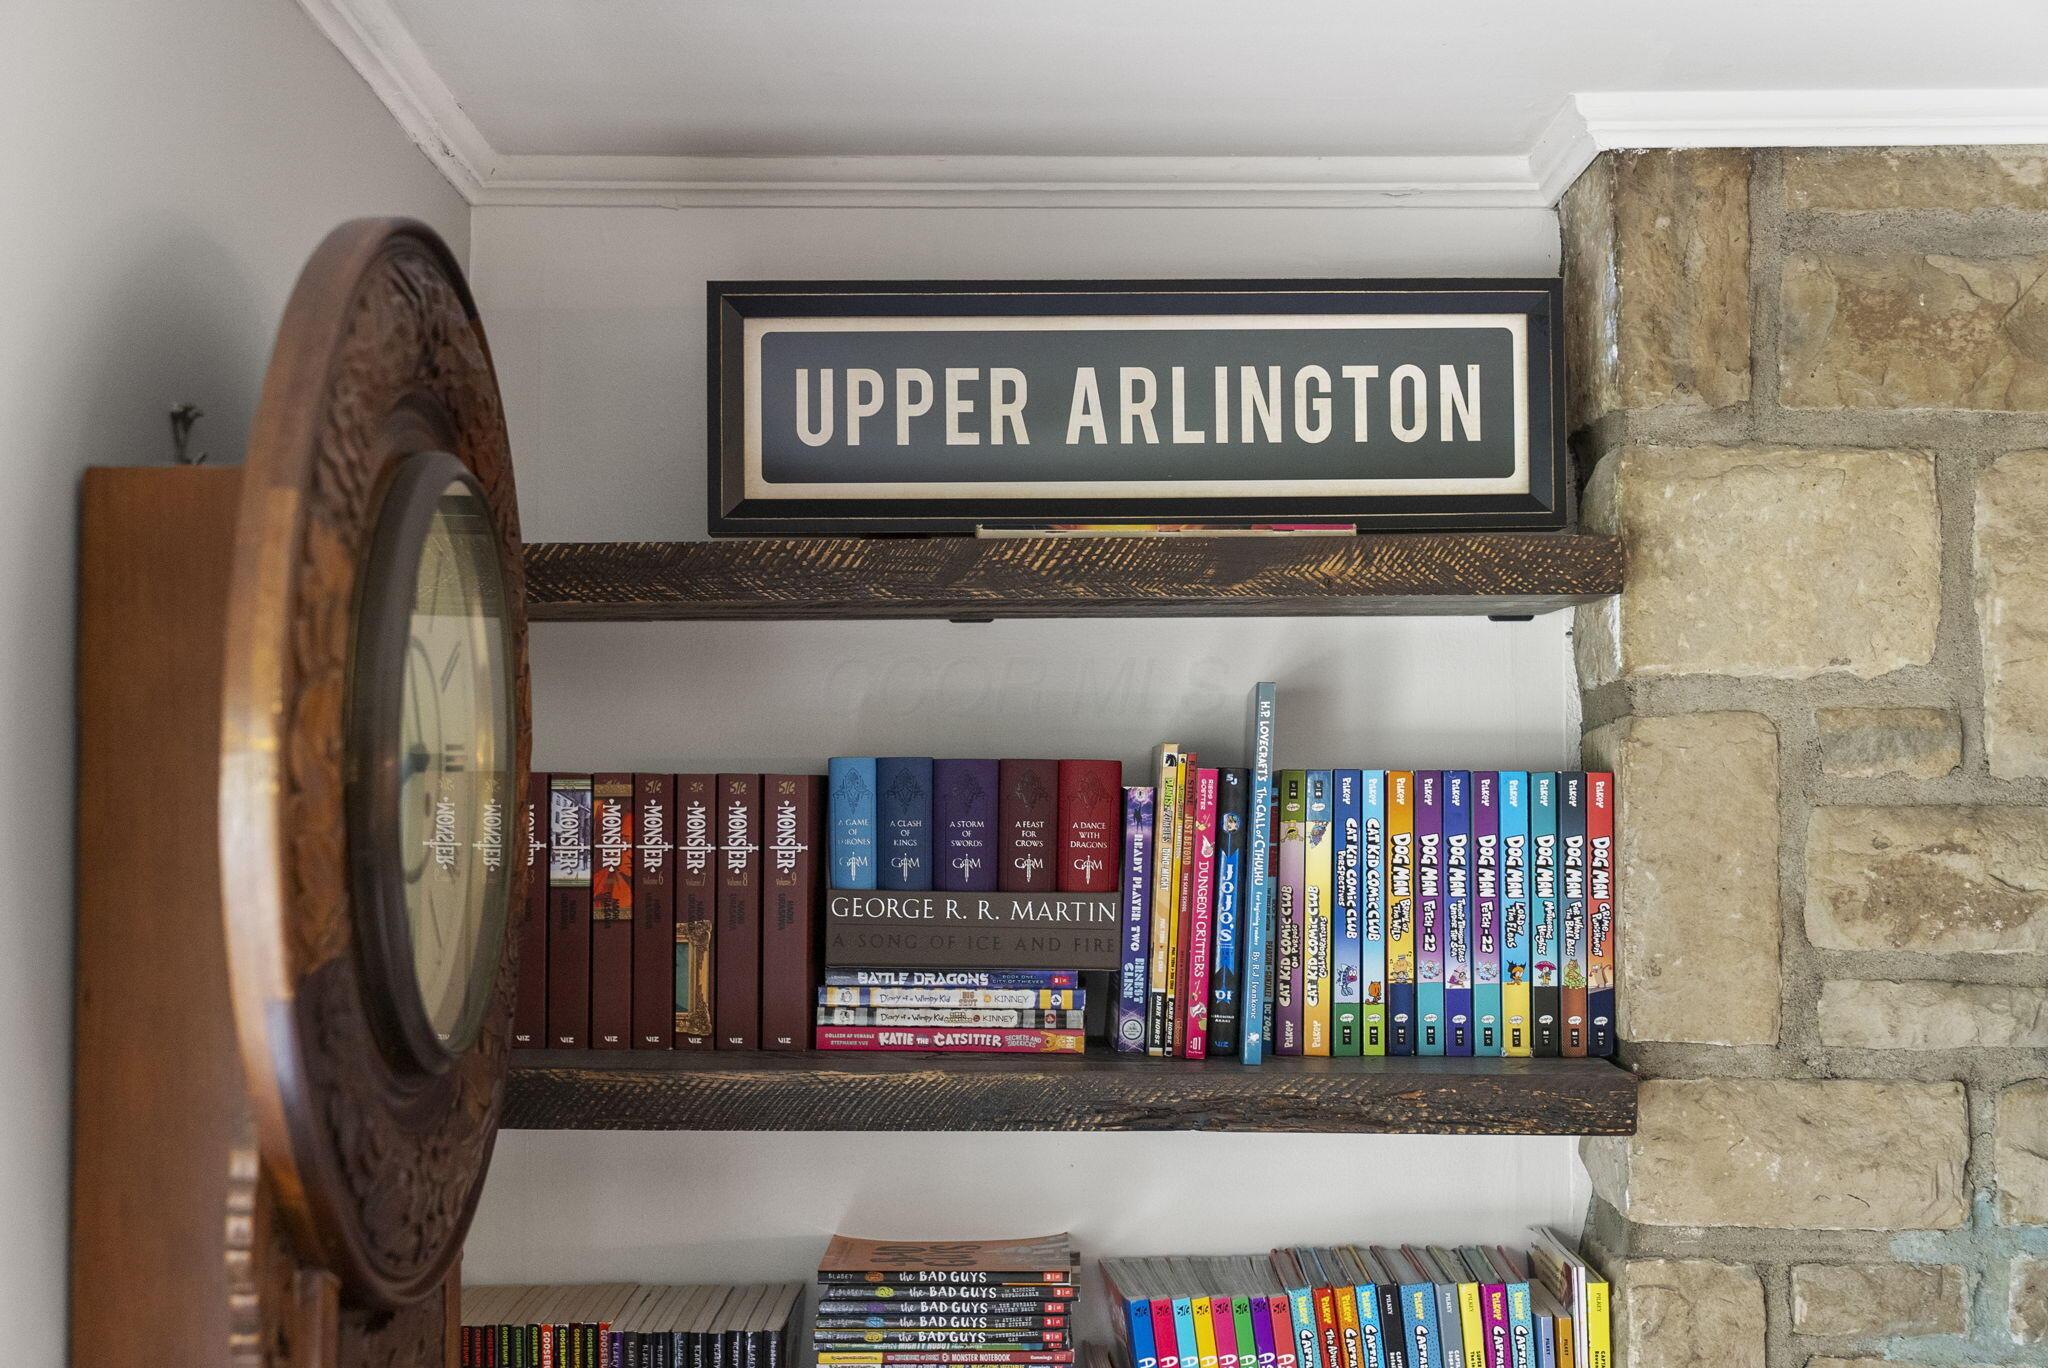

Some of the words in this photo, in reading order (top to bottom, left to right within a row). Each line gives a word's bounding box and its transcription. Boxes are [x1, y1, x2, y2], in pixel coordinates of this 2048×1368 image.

[796, 367, 1030, 447] UPPER
[1066, 364, 1482, 446] ARLINGTON
[1260, 700, 1270, 718] H.P.
[1257, 721, 1270, 782] LOVECRAFT'S
[1165, 777, 1174, 806] PLANTS
[1256, 787, 1268, 803] The
[1184, 813, 1193, 835] JUST
[1254, 804, 1267, 827] CALL
[1346, 818, 1358, 842] CAT
[1367, 818, 1380, 843] CAT
[554, 806, 588, 871] MONSTER
[597, 803, 629, 869] MONSTER
[638, 803, 670, 870] MONSTER
[681, 805, 713, 871] MONSTER
[722, 805, 755, 871] MONSTER
[771, 805, 804, 871] MONSTER
[951, 840, 983, 848] SWORDS
[1182, 835, 1193, 865] BEYOND
[1255, 829, 1264, 840] of
[1391, 832, 1411, 865] DOG
[1420, 833, 1440, 866] DOG
[1448, 834, 1468, 866] DOG
[1477, 834, 1497, 866] DOG
[1133, 834, 1144, 873] READY
[1253, 840, 1266, 886] CTHULHU
[1505, 835, 1525, 867] DOG
[1536, 834, 1555, 867] DOG
[1565, 835, 1584, 867] DOG
[1591, 836, 1611, 868] DOG
[1196, 861, 1209, 919] DUNGEON
[1391, 865, 1410, 896] MAN
[1420, 866, 1439, 897] MAN
[1449, 866, 1467, 897] MAN
[1478, 866, 1496, 898] MAN
[1506, 867, 1524, 899] MAN
[1537, 867, 1555, 899] MAN
[1565, 868, 1583, 899] MAN
[1592, 868, 1611, 900] MAN
[831, 896, 935, 919] GEORGE
[945, 899, 967, 920] R.
[978, 900, 1000, 920] R.
[1010, 900, 1116, 922] MARTIN
[1131, 876, 1142, 921] PLAYER
[1219, 864, 1234, 942] JOJO'S
[1281, 885, 1293, 916] CLUB
[1308, 885, 1320, 915] CLUB
[1130, 925, 1141, 952] TWO
[1346, 908, 1358, 939] CLUB
[1368, 909, 1381, 941] CLUB
[858, 934, 917, 949] SONG
[930, 935, 956, 949] OF
[967, 936, 1000, 951] ICE
[1015, 938, 1061, 951] AND
[1074, 938, 1114, 953] FIRE
[1194, 923, 1206, 978] CRITTERS
[1252, 951, 1261, 962] By
[857, 971, 909, 985] BATTLE
[914, 972, 989, 986] DRAGONS
[1291, 957, 1299, 969] ON
[1123, 962, 1134, 999] CLINE
[1133, 957, 1145, 1004] ERNEST
[1279, 984, 1291, 1008] CAT
[1306, 983, 1319, 1007] CAT
[880, 993, 901, 1004] Diary
[915, 994, 938, 1003] Wimpy
[940, 994, 951, 1003] Kid
[994, 995, 1029, 1004] KINNEY
[1250, 981, 1260, 1019] Ivankovic
[1264, 1003, 1272, 1014] DC
[881, 1013, 900, 1022] Diary
[912, 1014, 933, 1022] Wimpy
[934, 1013, 944, 1021] Kid
[982, 1014, 1015, 1022] KINNEY
[1263, 1016, 1272, 1041] ZOOM
[879, 1032, 915, 1046] KATIE
[916, 1037, 929, 1045] THE
[934, 1032, 1002, 1047] CATSITTER
[899, 1271, 916, 1282] the
[919, 1271, 947, 1282] BAD
[950, 1271, 987, 1283] GUYS
[909, 1286, 926, 1297] the
[929, 1286, 957, 1298] BAD
[960, 1286, 997, 1299] GUYS
[900, 1302, 917, 1313] the
[920, 1301, 948, 1313] BAD
[951, 1301, 988, 1314] GUYS
[1385, 1294, 1393, 1315] PILKEY
[898, 1332, 914, 1342] the
[918, 1331, 946, 1342] BAD
[949, 1331, 986, 1343] GUYS
[899, 1317, 916, 1328] the
[919, 1316, 947, 1328] BAD
[950, 1316, 987, 1328] GUYS
[951, 1353, 978, 1361] MONSTER
[979, 1353, 1011, 1361] NOTEBOOK
